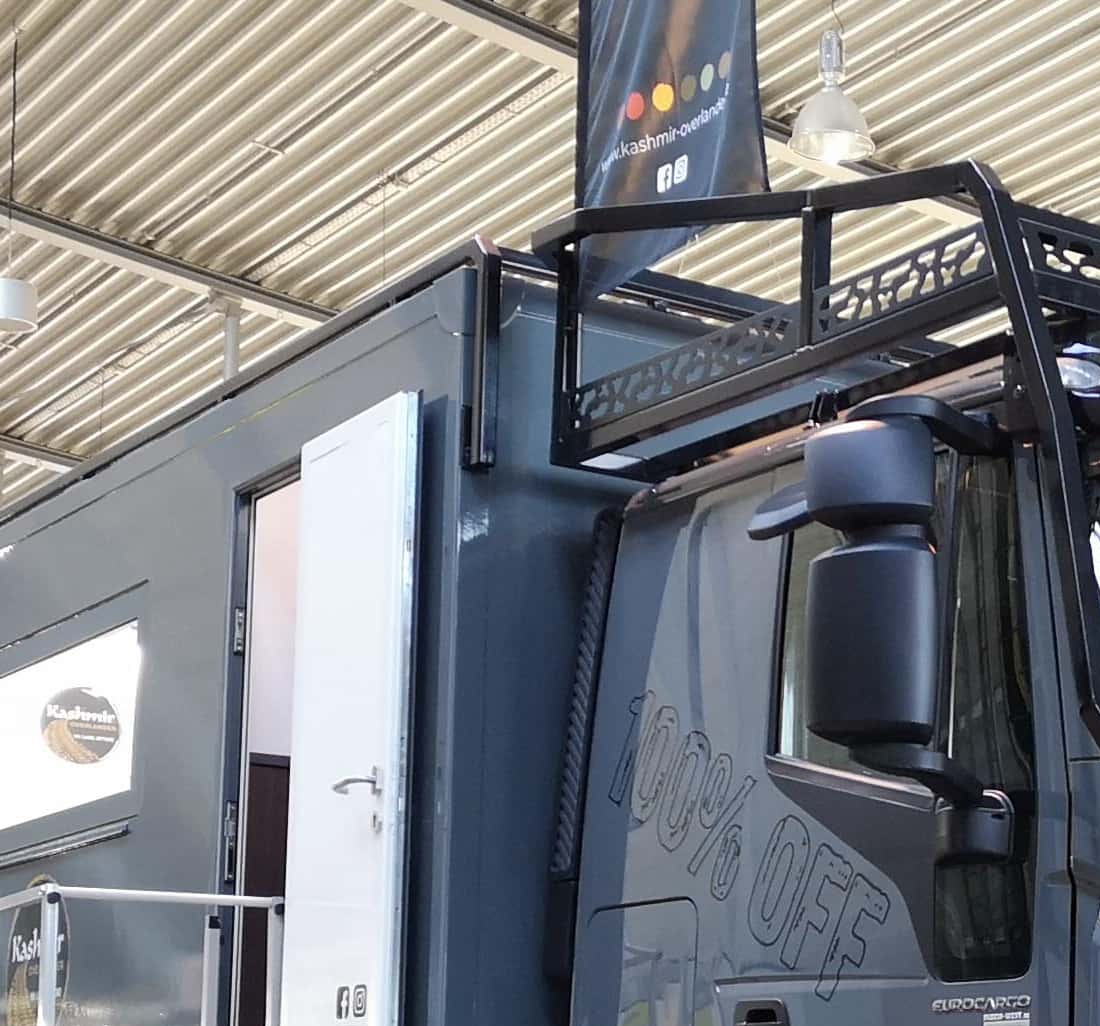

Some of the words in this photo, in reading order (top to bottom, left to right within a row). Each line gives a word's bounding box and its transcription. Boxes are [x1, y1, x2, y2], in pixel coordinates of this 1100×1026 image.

[47, 704, 116, 723] Kashmir
[608, 690, 757, 901] 100%
[749, 814, 891, 1002] OFF
[11, 928, 65, 963] Kashr
[932, 994, 1031, 1012] EUROCARGO
